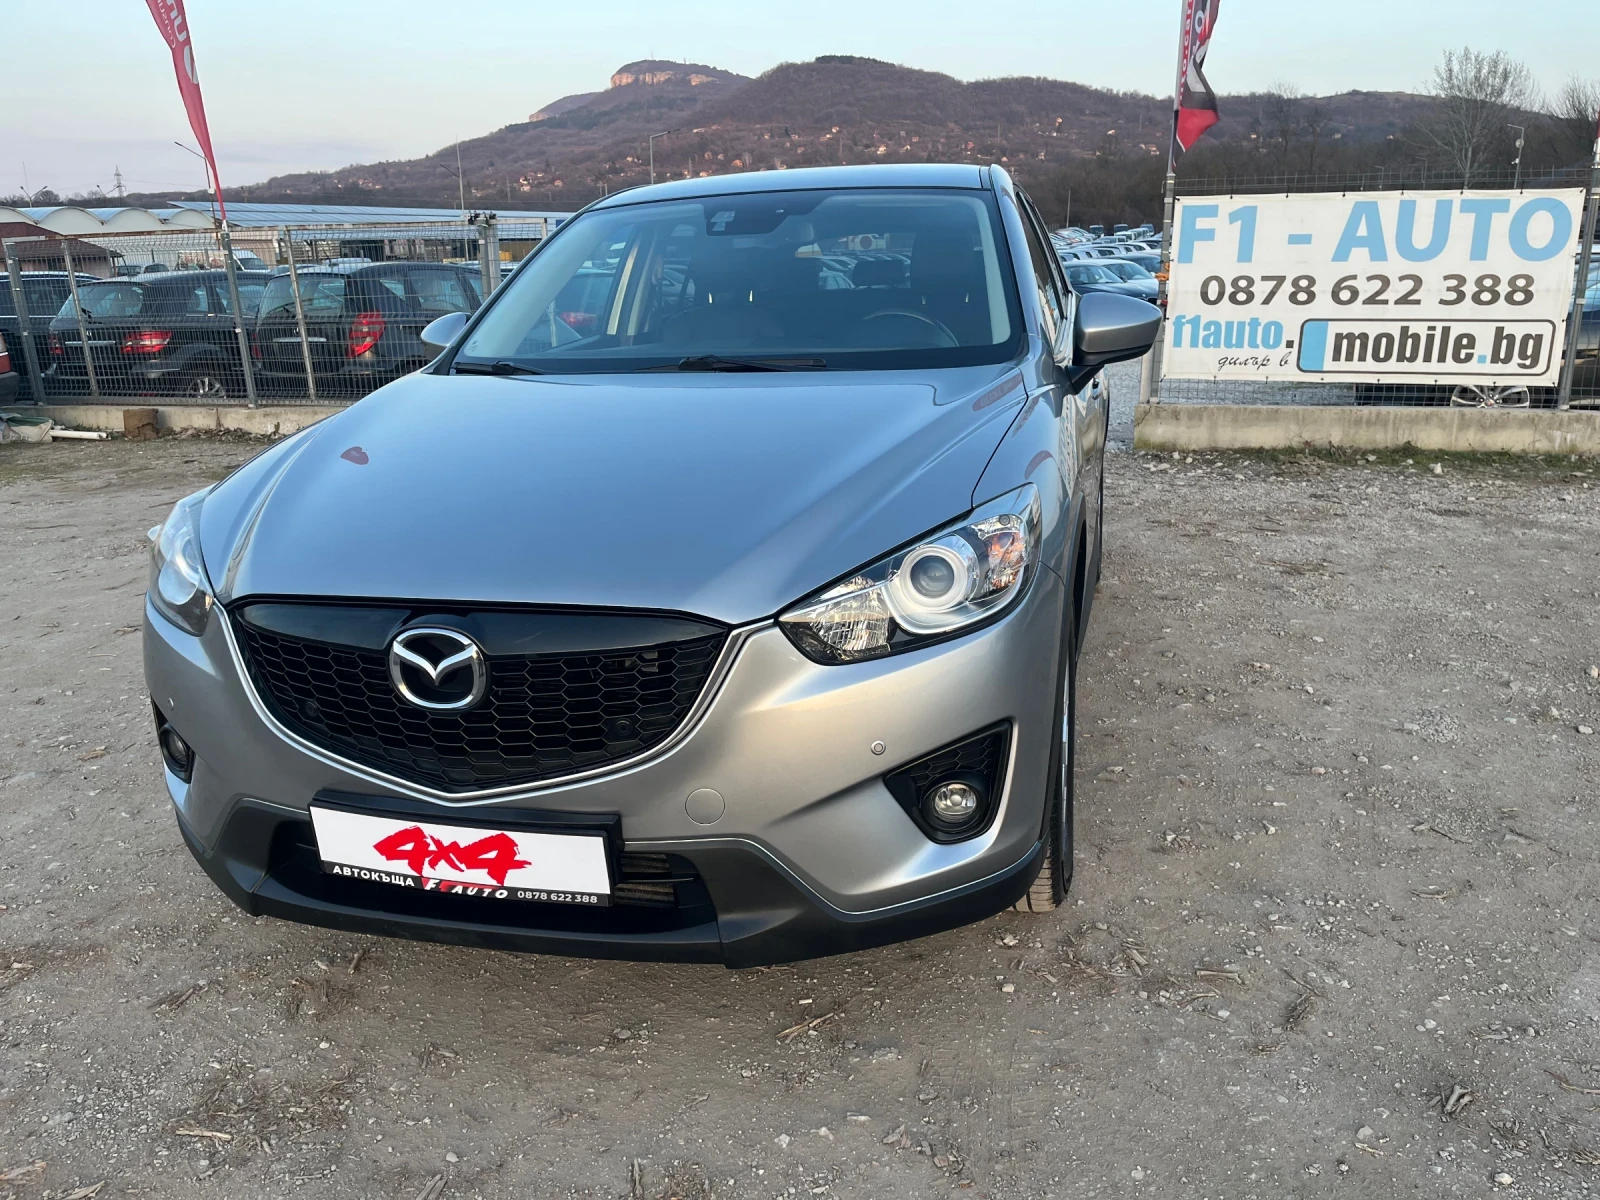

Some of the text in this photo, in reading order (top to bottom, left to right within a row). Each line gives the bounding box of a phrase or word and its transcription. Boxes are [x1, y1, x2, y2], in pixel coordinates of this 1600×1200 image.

[1177, 204, 1258, 264] F1
[1331, 197, 1573, 263] AUTO
[1200, 273, 1535, 307] 0878 622 388
[1218, 354, 1271, 371] дилър
[1331, 325, 1544, 370] mobile.bg
[332, 865, 415, 887] АВТОКЪЩА
[451, 885, 509, 899] AUTO
[517, 890, 548, 900] 0878
[550, 892, 572, 902] 622
[574, 894, 598, 903] 388
